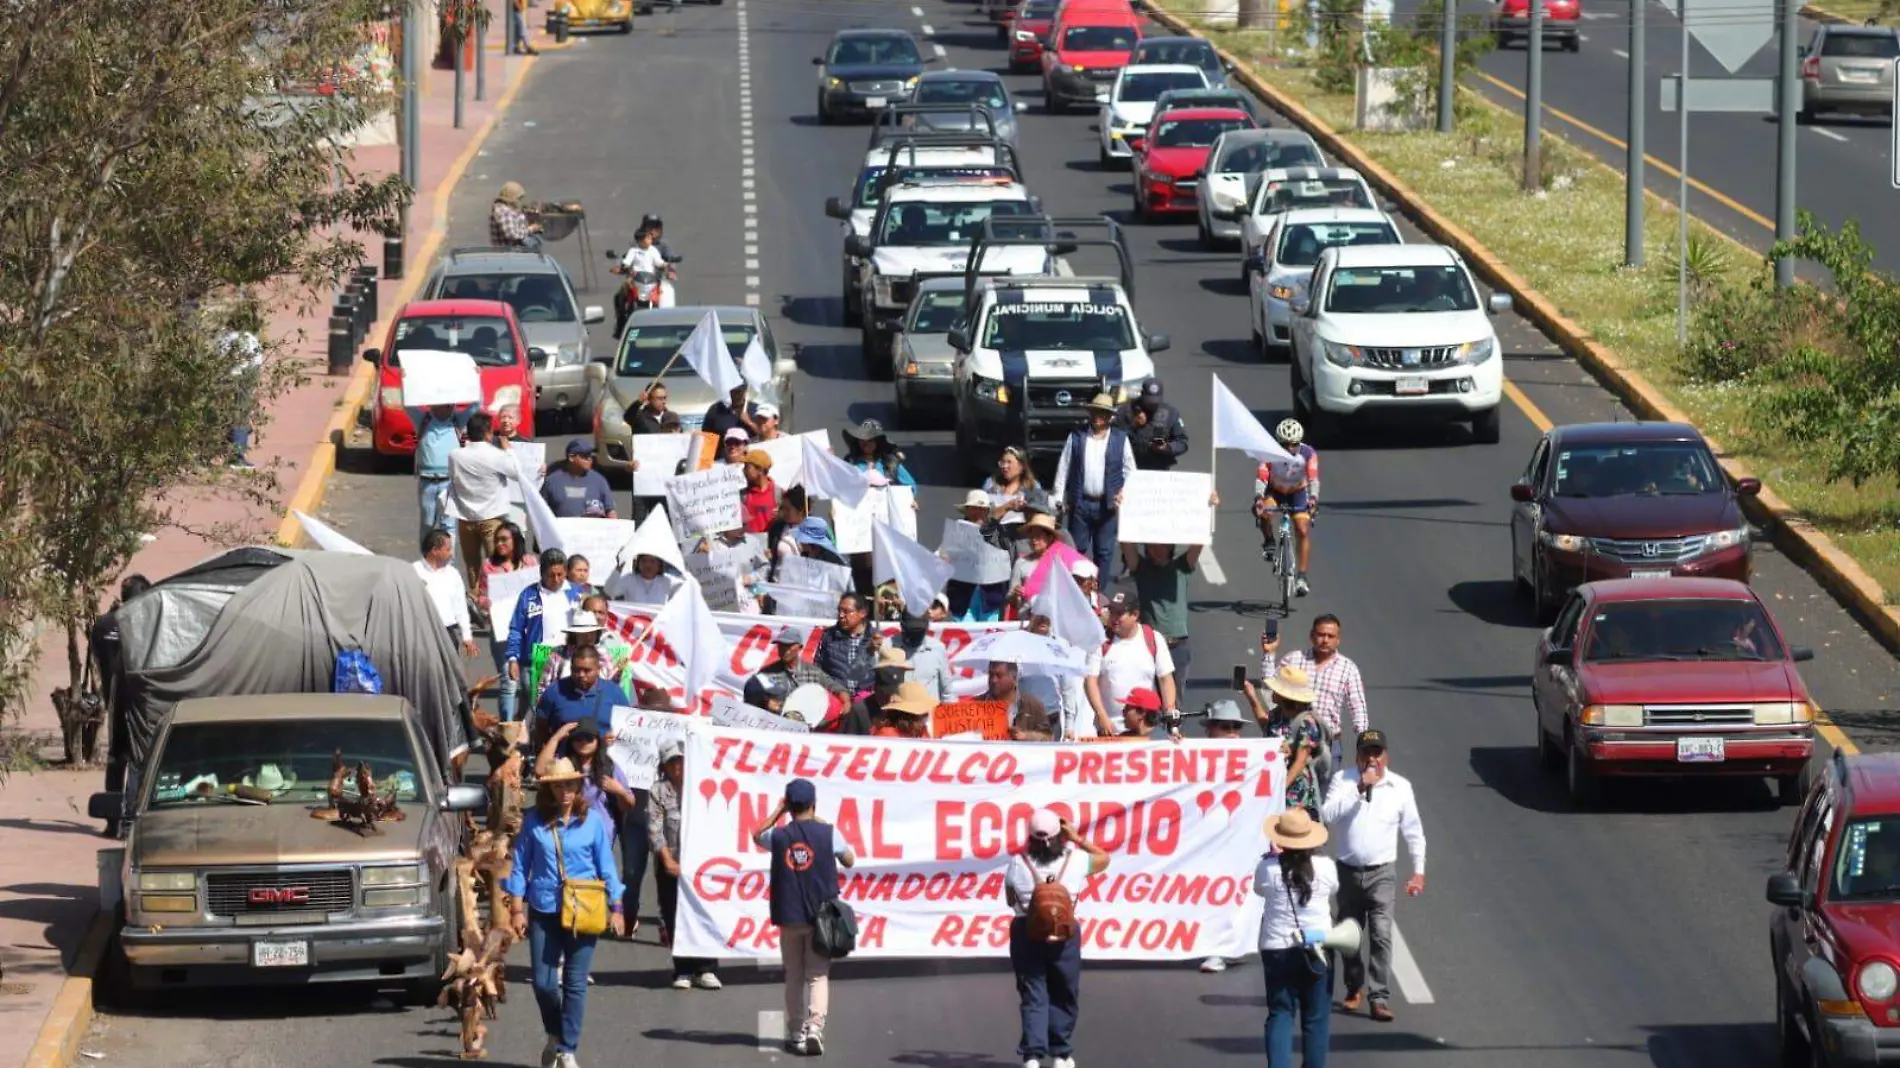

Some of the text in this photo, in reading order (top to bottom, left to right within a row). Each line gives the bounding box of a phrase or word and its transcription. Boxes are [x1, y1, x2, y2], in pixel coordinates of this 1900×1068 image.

[712, 737, 1025, 787] TLALTELULCO,
[836, 797, 904, 858] AL
[248, 886, 309, 904] GMC
[1078, 872, 1253, 907] XIGIMOS
